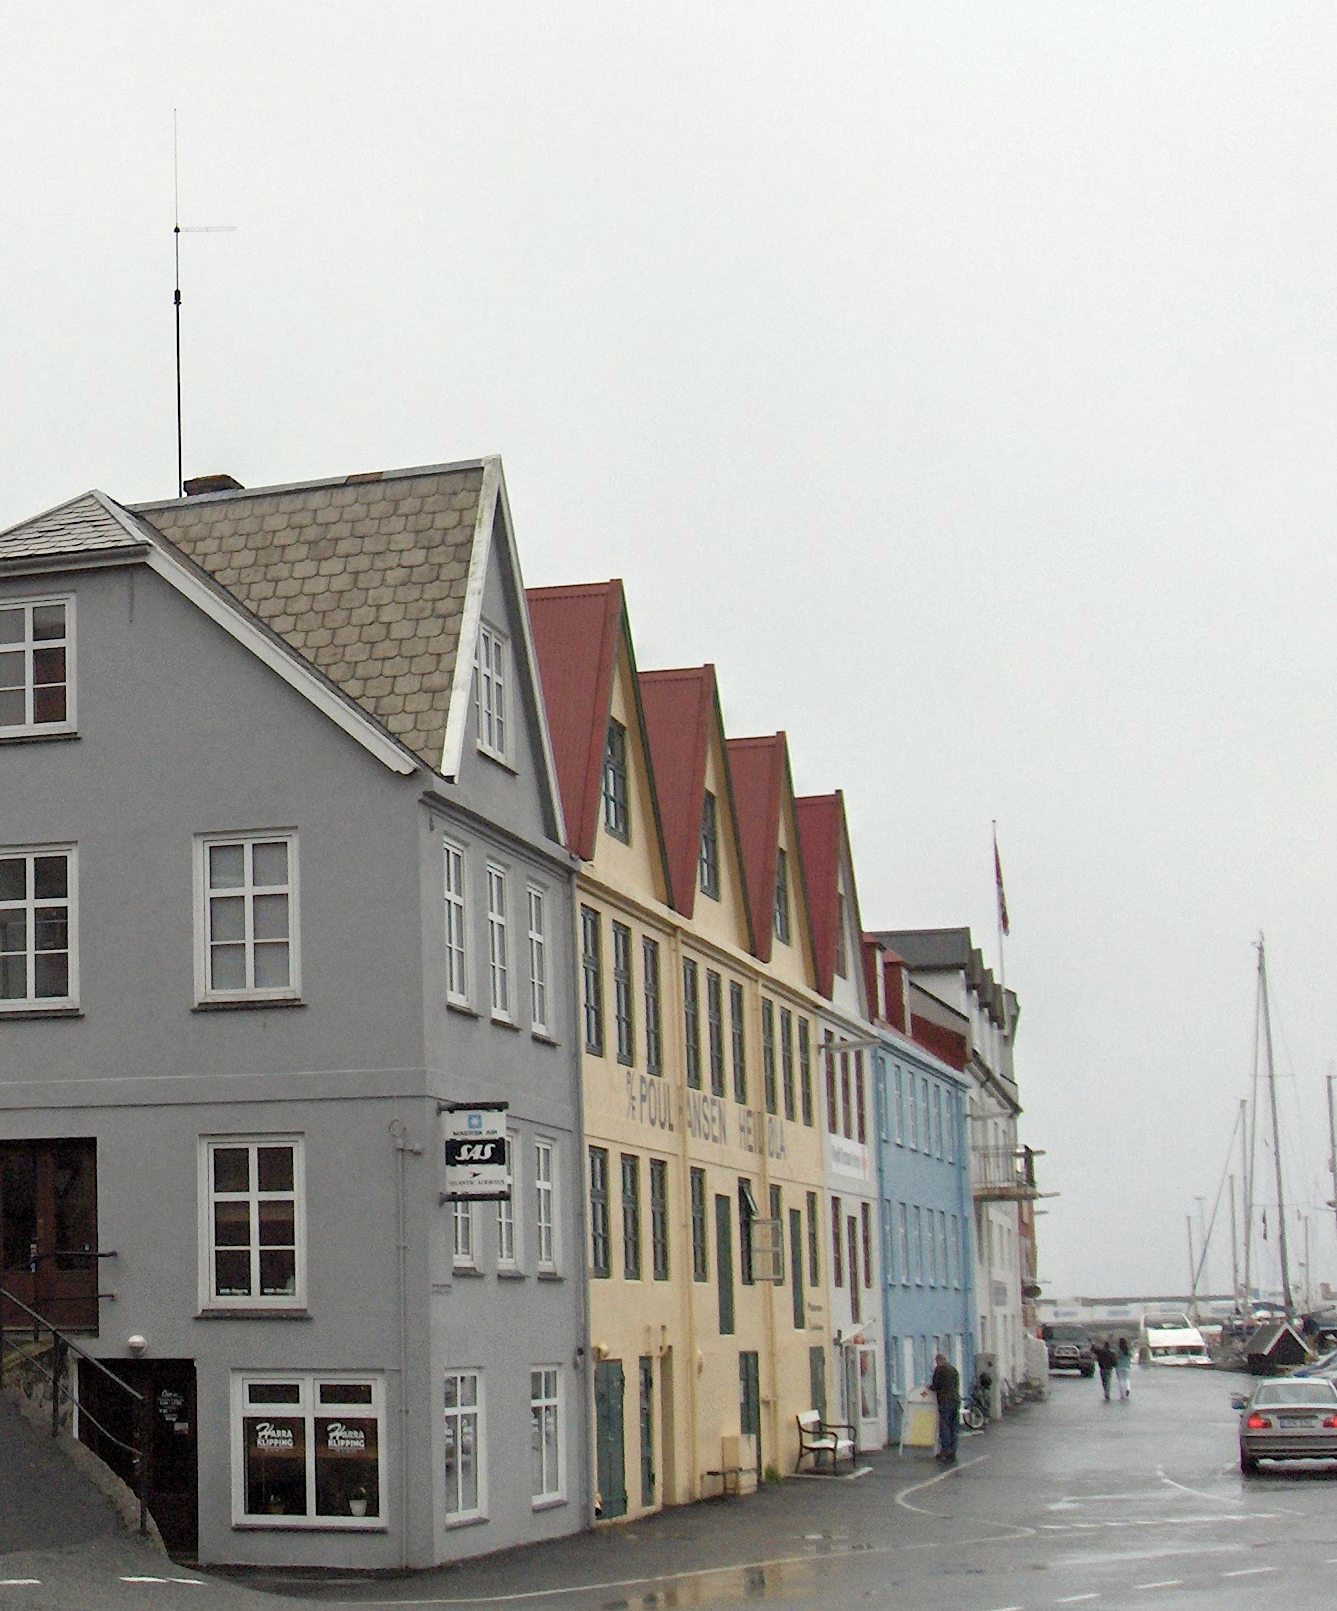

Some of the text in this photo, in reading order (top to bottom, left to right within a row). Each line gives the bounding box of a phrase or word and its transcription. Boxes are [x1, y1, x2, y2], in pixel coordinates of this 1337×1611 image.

[640, 1074, 674, 1132] POUL
[454, 1143, 496, 1161] SAS
[257, 1438, 294, 1447] KLIPPING
[328, 1439, 365, 1448] KLIPPING
